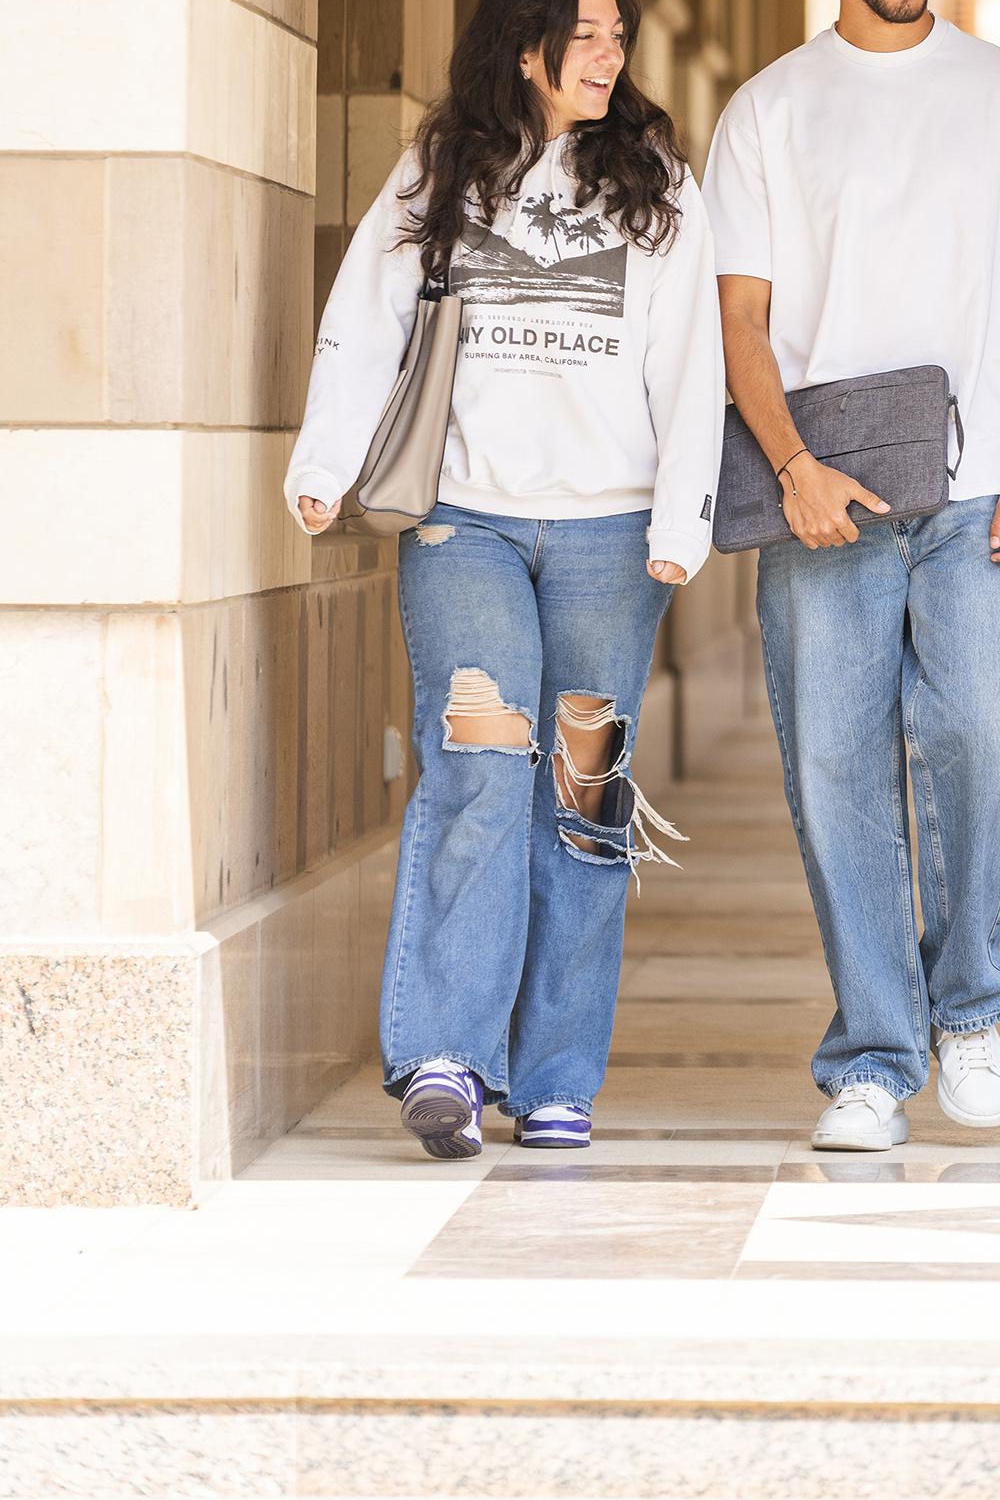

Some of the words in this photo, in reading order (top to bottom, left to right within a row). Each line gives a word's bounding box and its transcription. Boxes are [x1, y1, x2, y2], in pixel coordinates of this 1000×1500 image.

[491, 326, 538, 346] OLD
[544, 331, 620, 356] PLACE
[464, 352, 500, 360] SURFING
[502, 352, 517, 360] BAY
[519, 353, 543, 363] AREA,
[544, 356, 588, 367] CALIFORNIA
